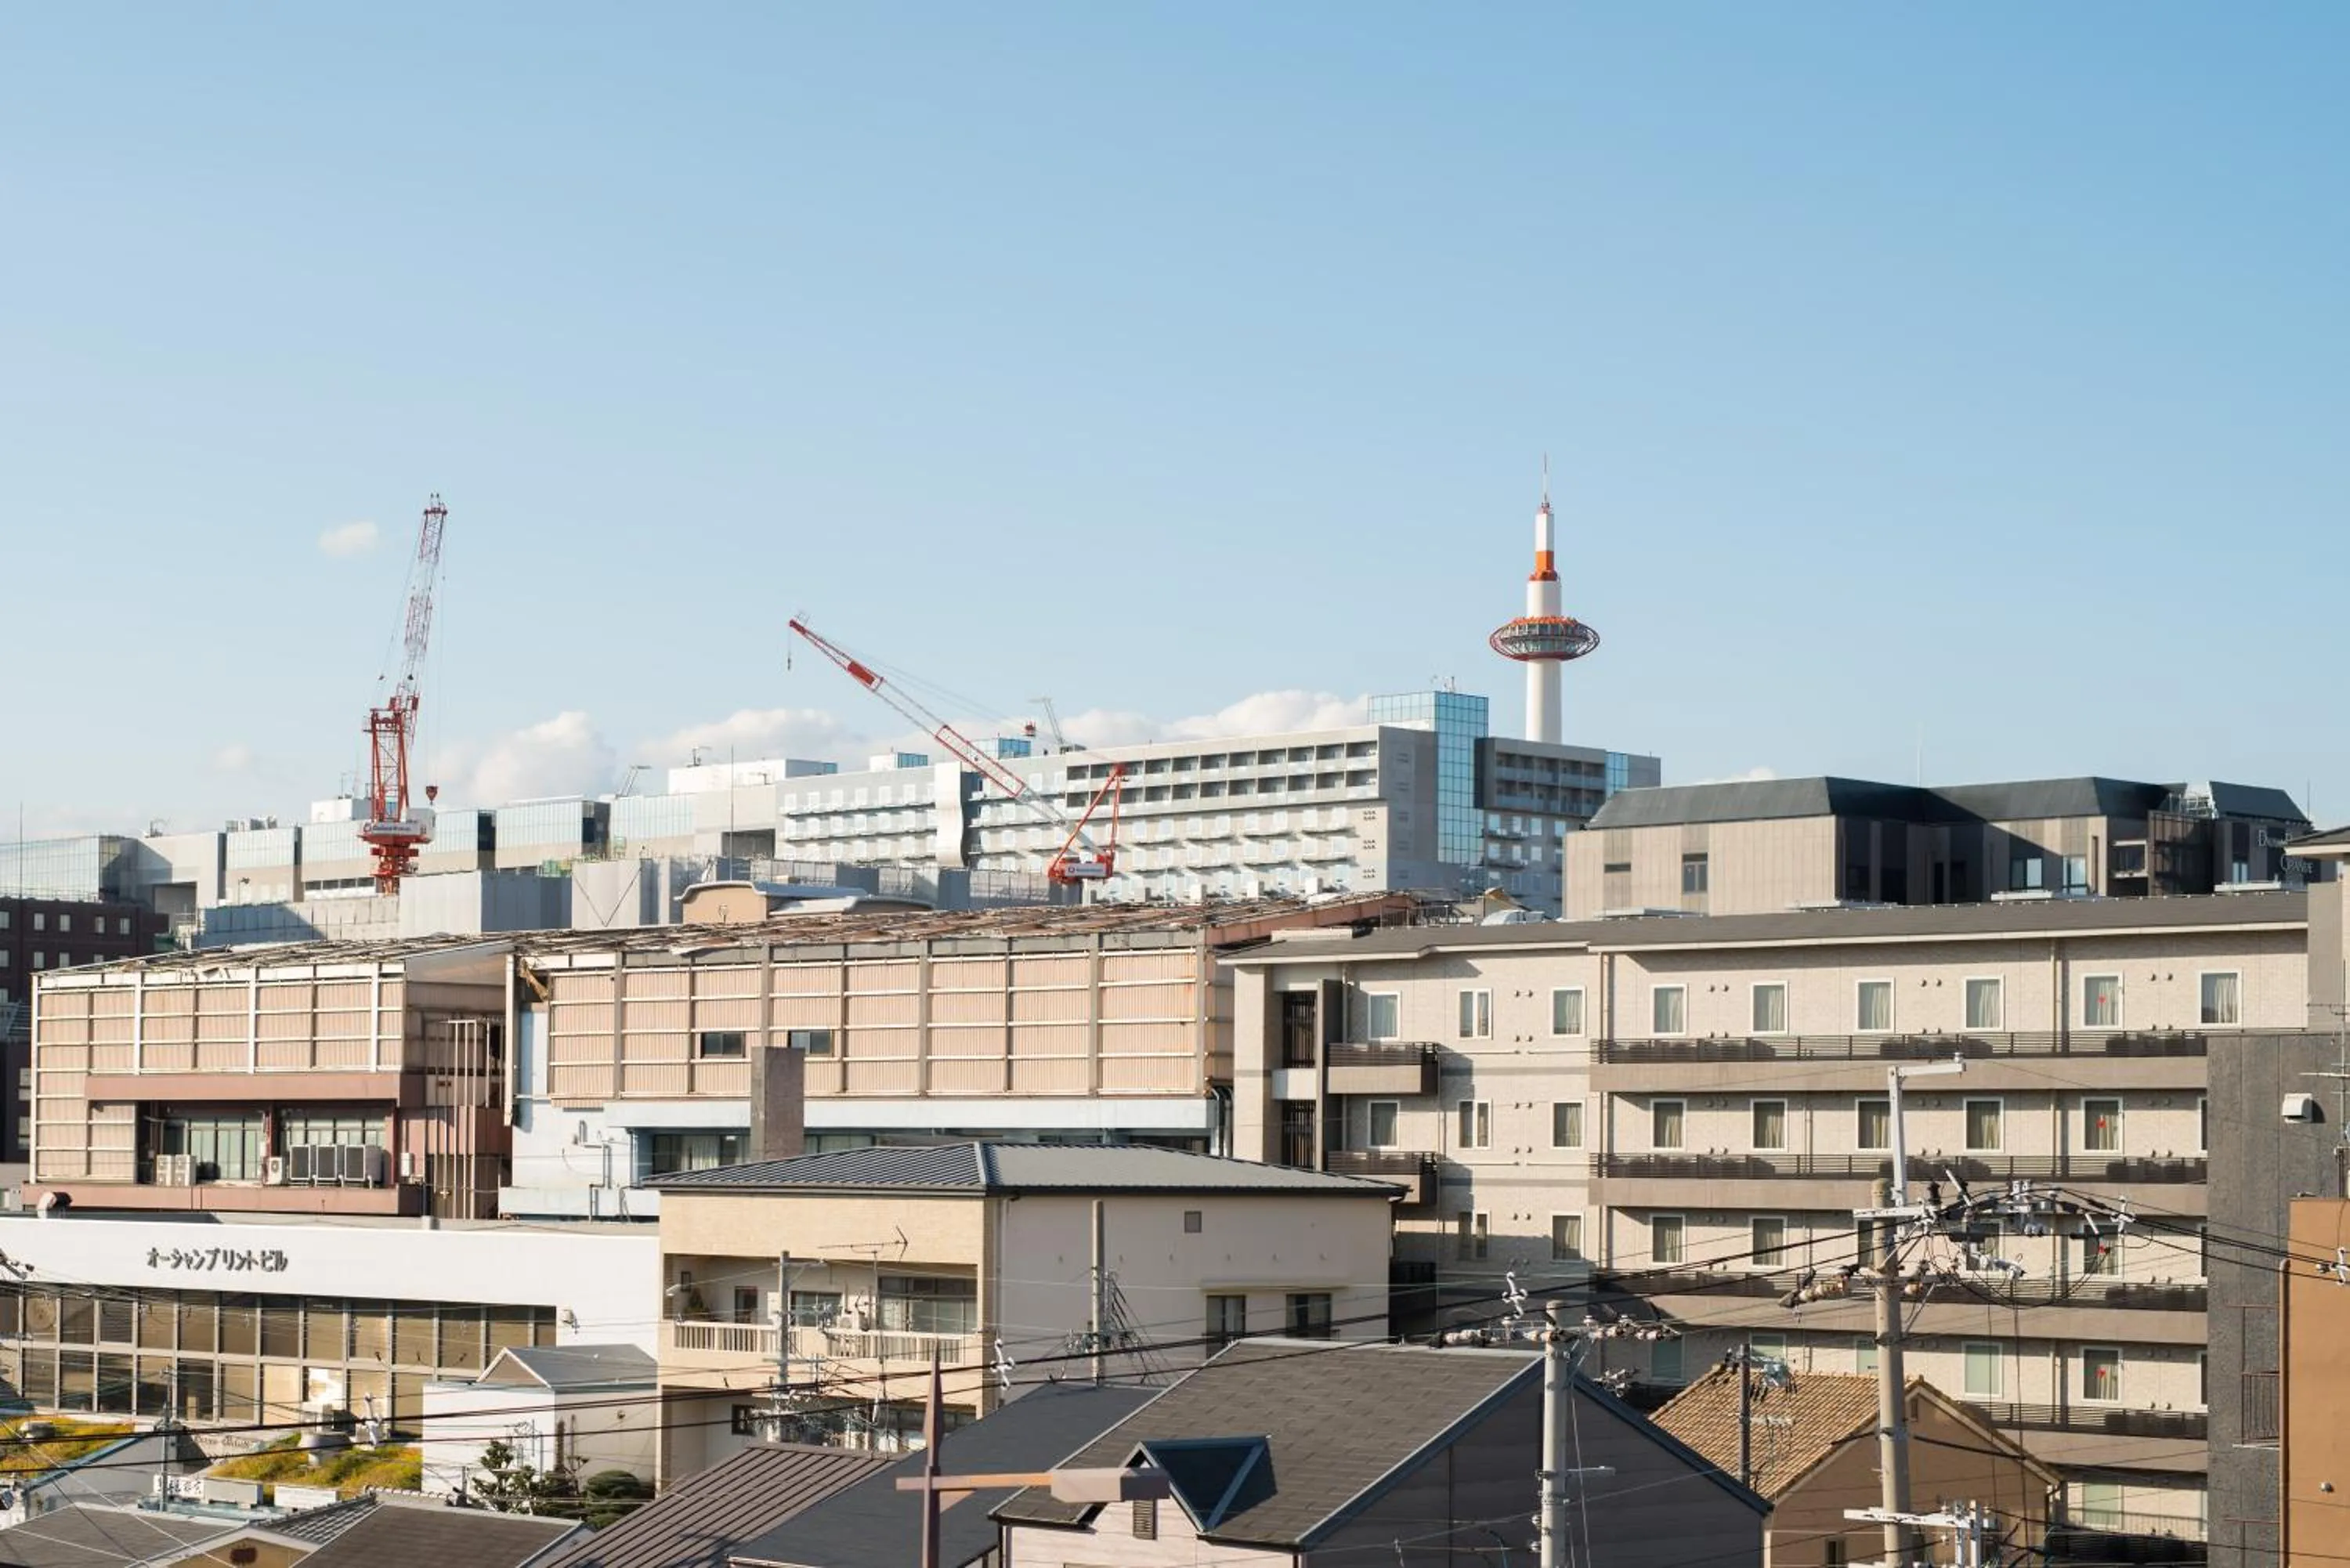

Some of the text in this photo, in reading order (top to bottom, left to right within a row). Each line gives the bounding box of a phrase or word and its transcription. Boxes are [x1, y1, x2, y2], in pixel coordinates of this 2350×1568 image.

[147, 1246, 288, 1272] オーシャンプリントビル
